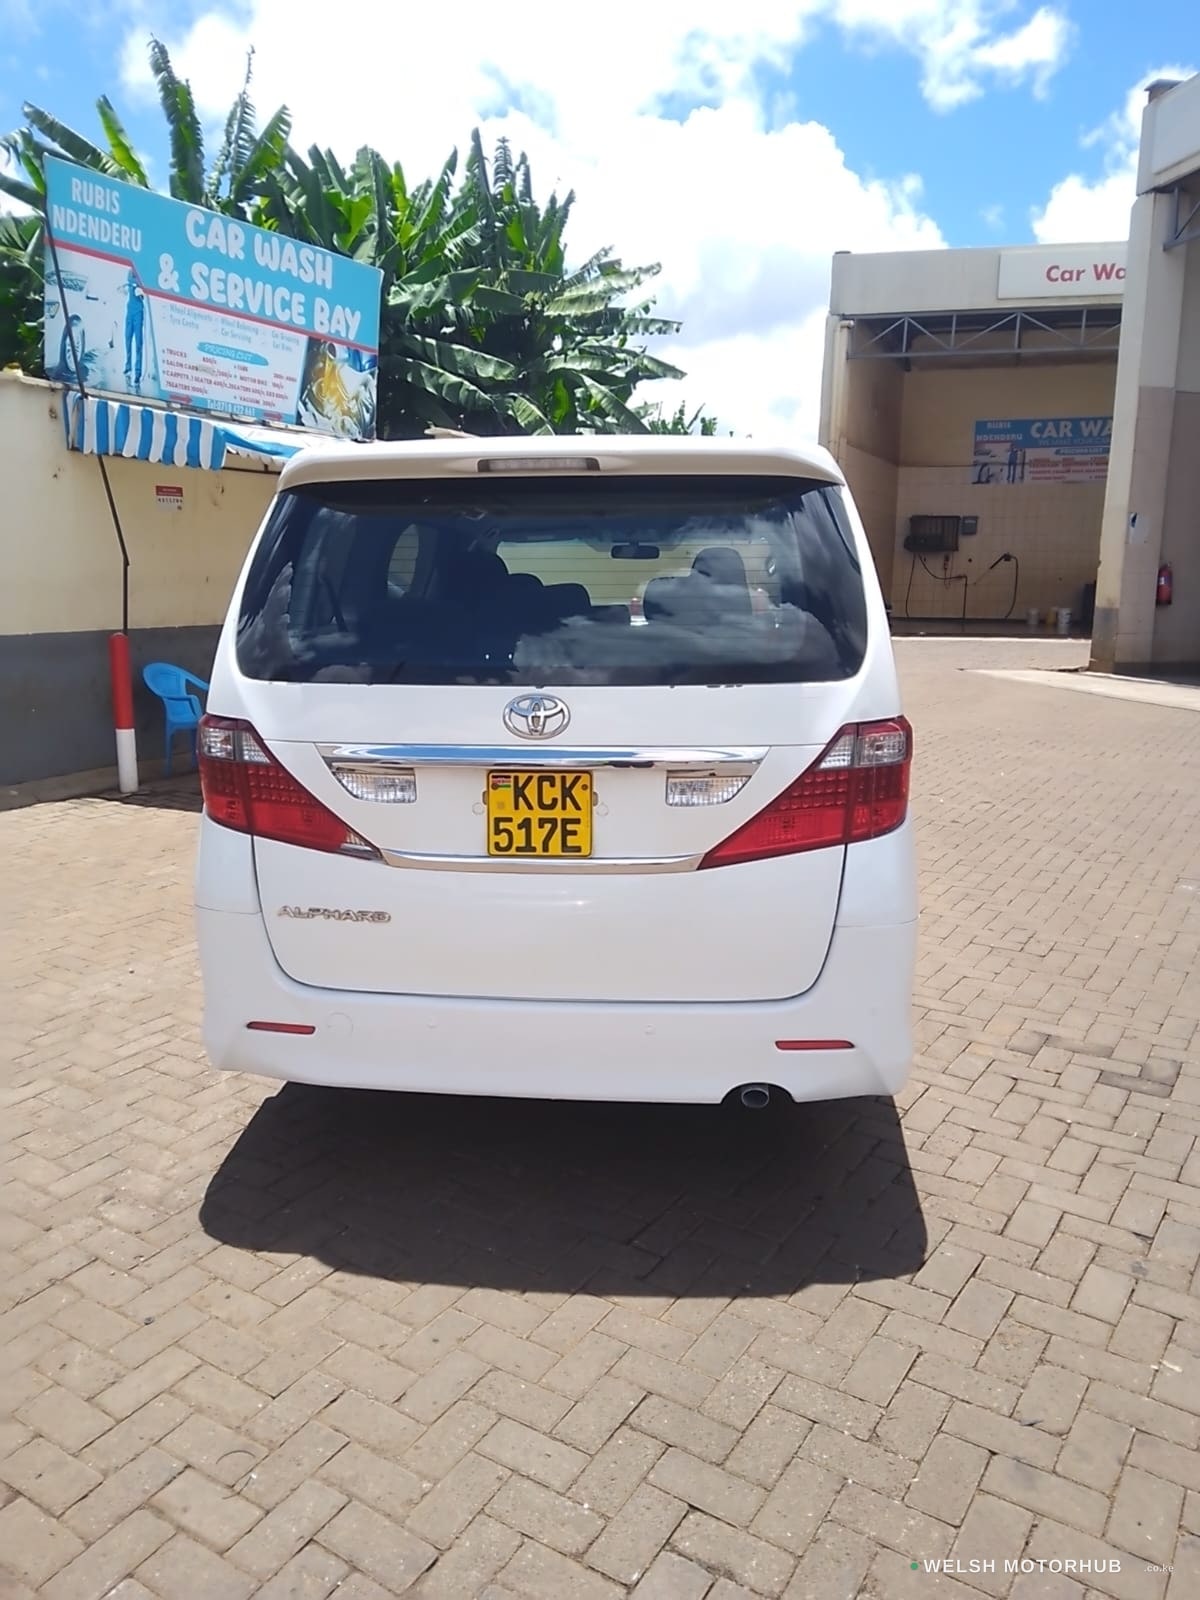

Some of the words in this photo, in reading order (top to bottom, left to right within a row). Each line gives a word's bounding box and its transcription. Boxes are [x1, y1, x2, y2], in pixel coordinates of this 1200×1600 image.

[71, 177, 120, 215] RUBIS
[52, 204, 142, 252] NDENDERU
[185, 209, 245, 260] CAR
[254, 233, 333, 290] WASH
[1046, 265, 1086, 282] Car
[158, 253, 180, 292] &
[190, 262, 306, 325] SERVICE
[314, 297, 361, 341] BAY
[1030, 421, 1072, 438] CAR
[513, 775, 582, 811] KCK
[493, 817, 582, 853] 517E
[277, 905, 391, 923] ALPHARD
